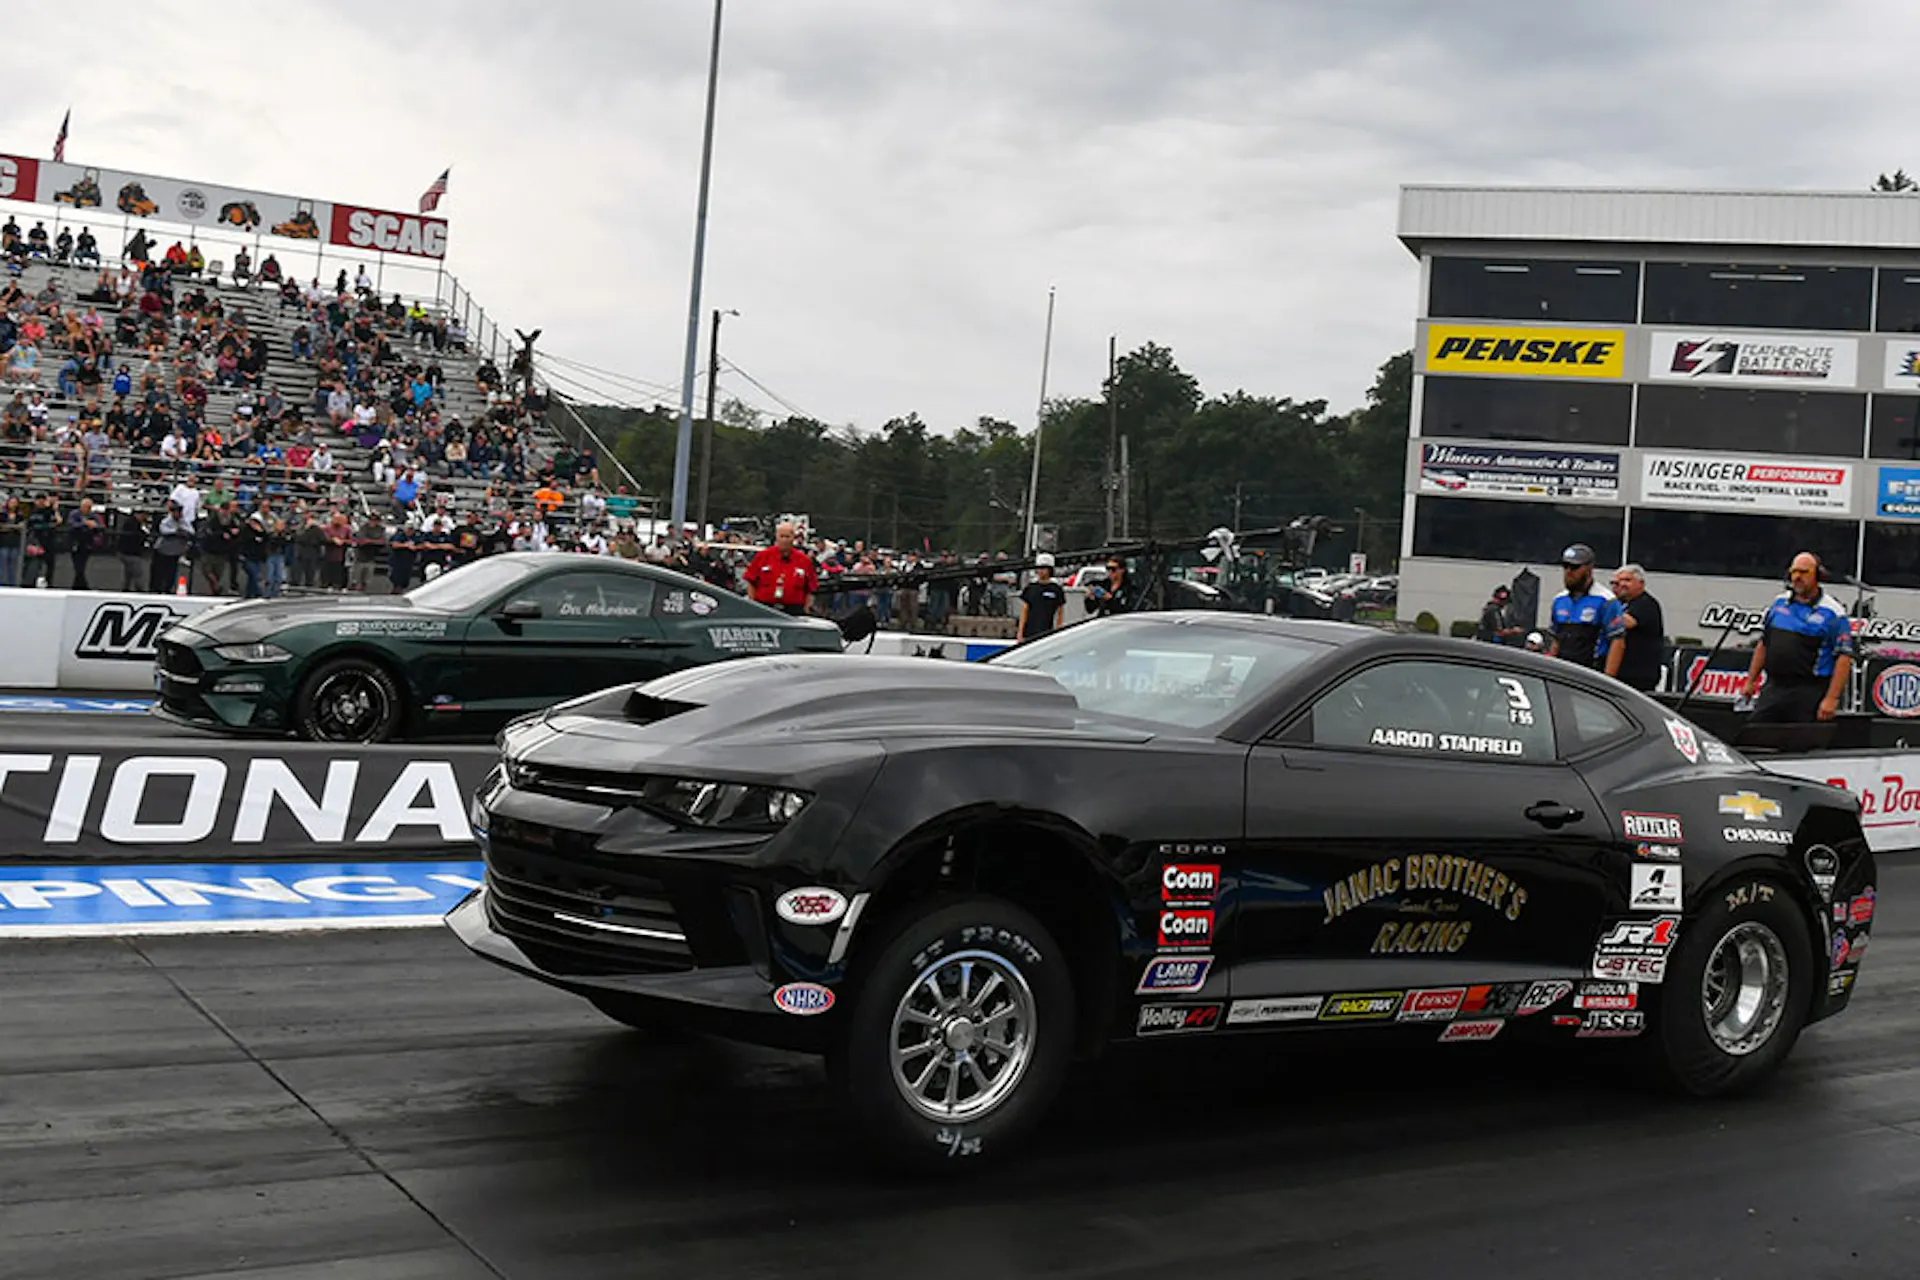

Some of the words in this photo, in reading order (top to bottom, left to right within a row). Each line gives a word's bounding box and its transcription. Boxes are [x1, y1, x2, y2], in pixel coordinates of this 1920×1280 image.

[348, 209, 447, 257] SCAG
[1434, 336, 1616, 366] PENSKE
[1742, 343, 1834, 358] FEATHER-LITE
[1740, 356, 1832, 371] BATTERIES
[1649, 460, 1746, 480] INSINGER
[1751, 467, 1839, 483] PERFORMANCE
[1664, 481, 1692, 490] RACE
[1694, 482, 1720, 492] FUEL
[1729, 484, 1790, 496] INDUSTRIAL
[1794, 487, 1829, 498] LUBES
[708, 627, 781, 648] VARSITY
[1498, 677, 1532, 710] 3
[1371, 728, 1434, 749] AARON
[1439, 734, 1523, 755] STANFIELD
[1723, 827, 1794, 845] CHEVROLET
[1159, 844, 1226, 854] COPO
[1163, 866, 1214, 890] Coan
[1323, 857, 1401, 925] JANAC
[1405, 853, 1529, 921] BROTHER'S
[1725, 881, 1775, 912] M/T
[1160, 911, 1209, 935] Coan
[1603, 920, 1673, 945] JR1
[961, 926, 1044, 964] FRONT
[1370, 920, 1472, 953] RACING
[1155, 962, 1199, 979] LAMB
[783, 988, 825, 1009] NHRA
[1142, 1007, 1188, 1028] Holley
